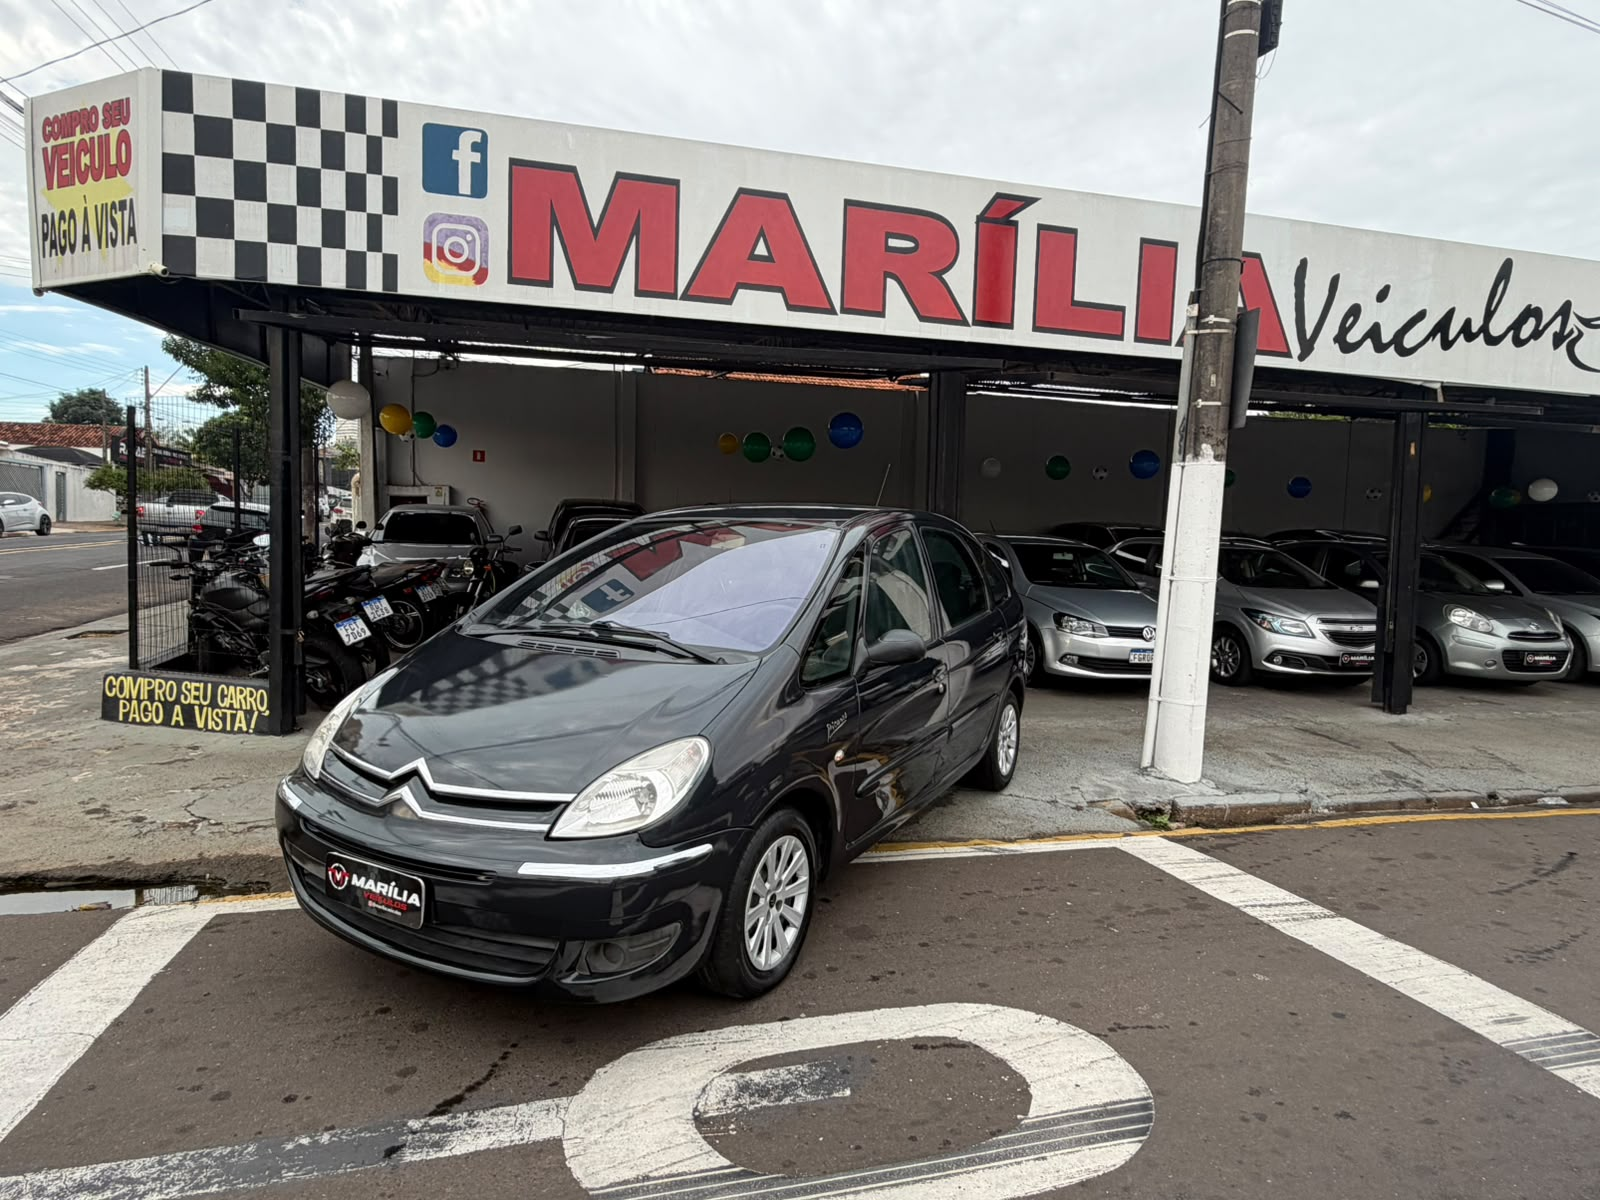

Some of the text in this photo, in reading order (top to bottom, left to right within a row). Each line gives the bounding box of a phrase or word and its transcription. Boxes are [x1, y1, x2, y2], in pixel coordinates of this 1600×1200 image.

[42, 97, 131, 143] COMPRO SEU
[42, 129, 132, 191] VEICULO
[41, 195, 137, 258] PAGO À VISTA
[105, 676, 177, 702] COMPRO
[180, 681, 212, 706] SEU
[118, 700, 259, 733] PAGO A VISTA!
[351, 873, 421, 908] MARÍLIA
